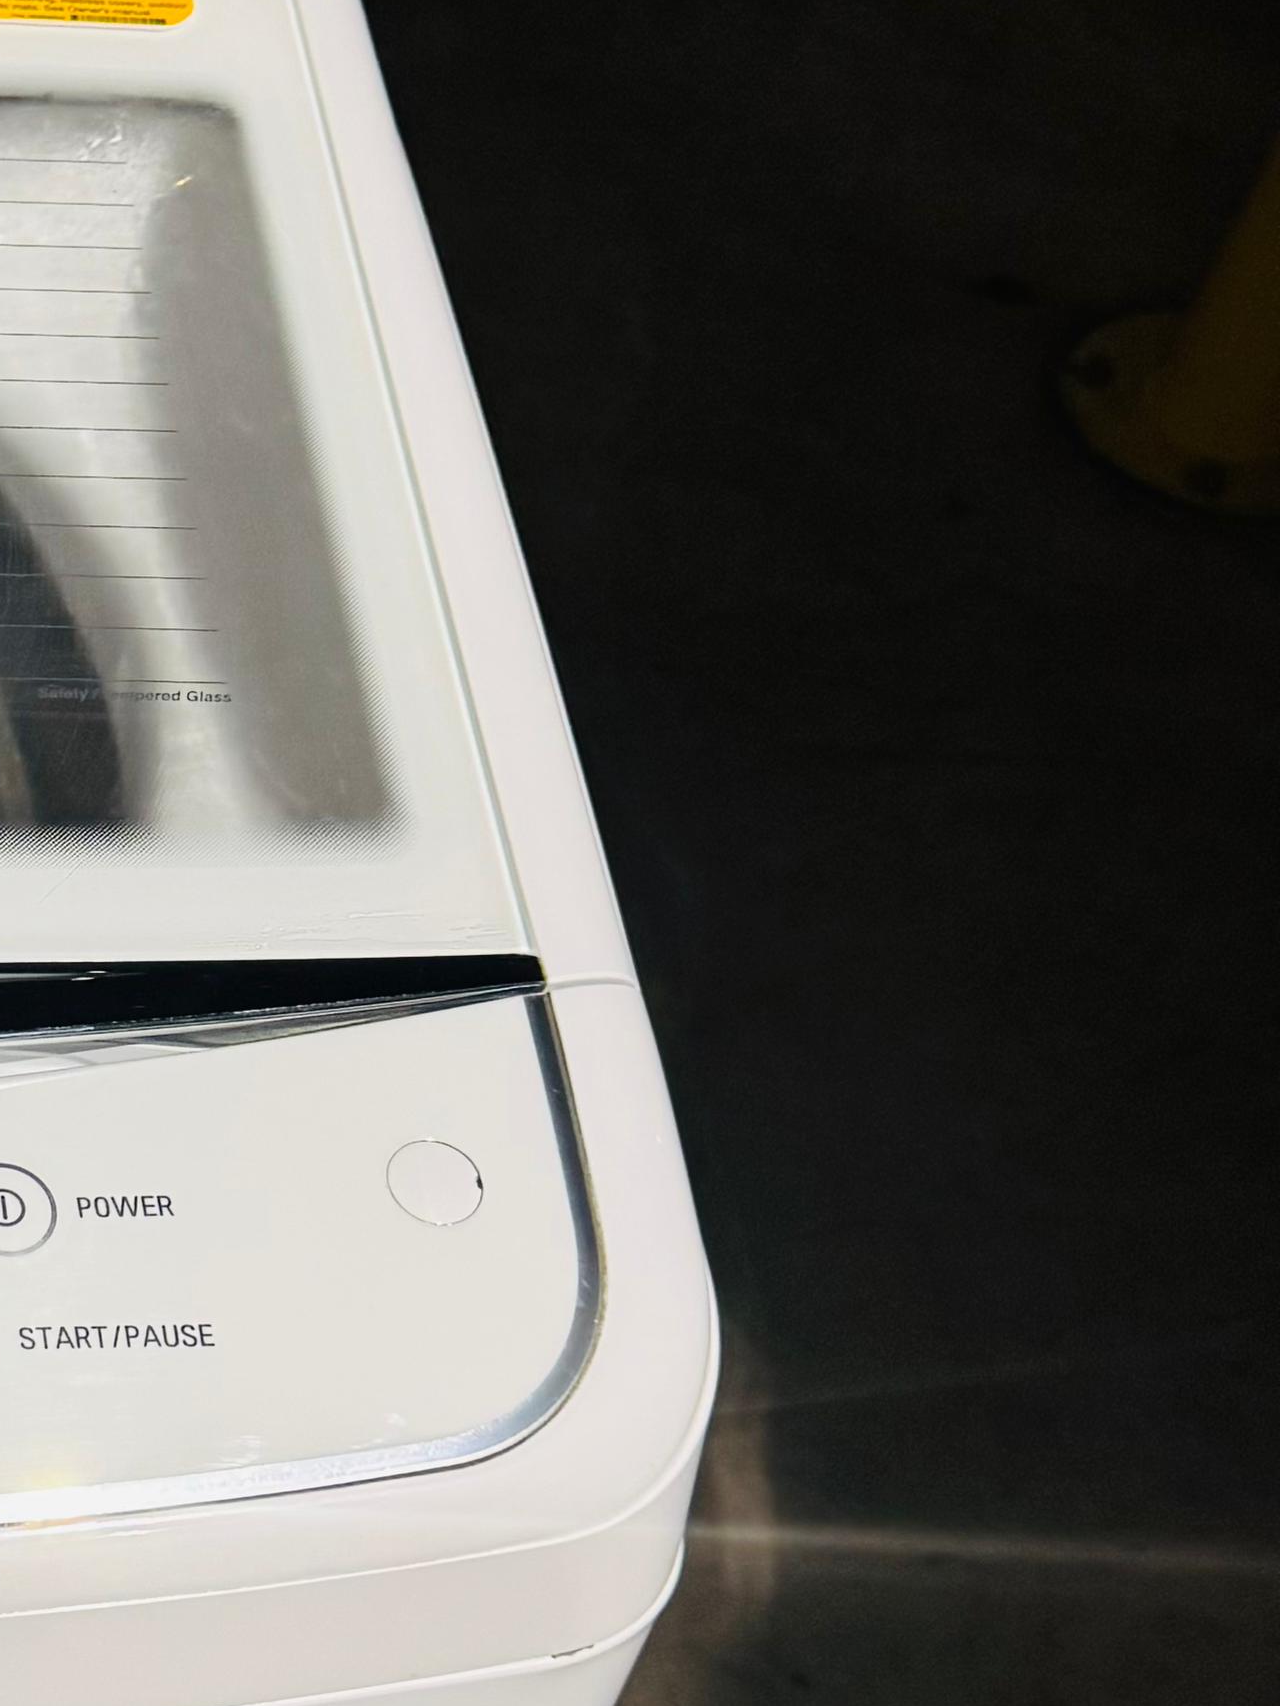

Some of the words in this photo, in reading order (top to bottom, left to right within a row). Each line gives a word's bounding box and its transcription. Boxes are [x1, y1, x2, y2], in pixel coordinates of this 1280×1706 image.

[187, 690, 232, 704] Glass
[76, 1195, 175, 1219] POWER
[19, 1324, 216, 1350] START/PAUSE
